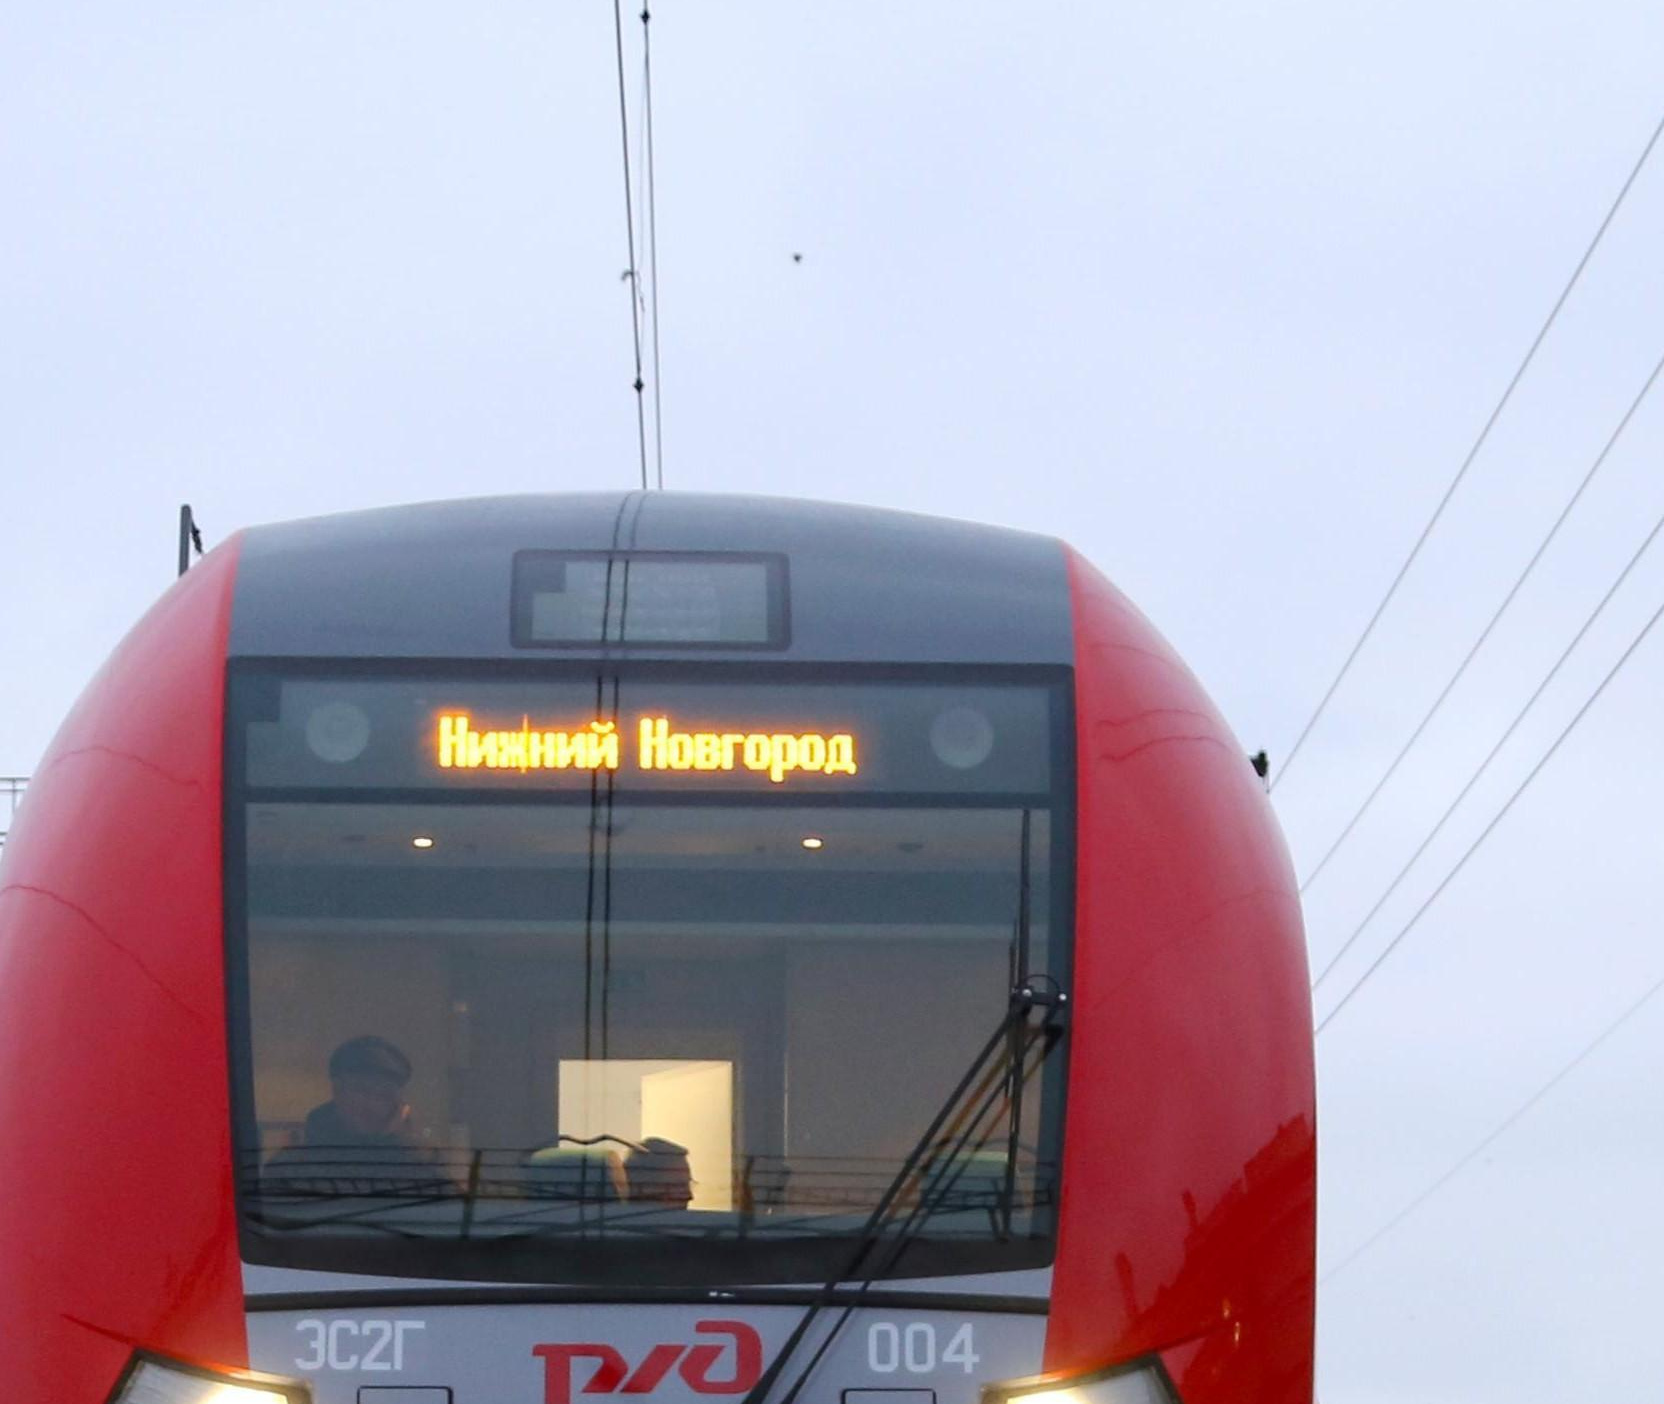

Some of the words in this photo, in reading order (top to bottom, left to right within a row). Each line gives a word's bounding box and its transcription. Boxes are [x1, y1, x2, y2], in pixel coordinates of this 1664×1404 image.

[438, 714, 619, 771] Нижний
[639, 716, 857, 783] Новгород
[294, 1318, 426, 1371] ЭС2Г
[867, 1321, 981, 1374] 004
